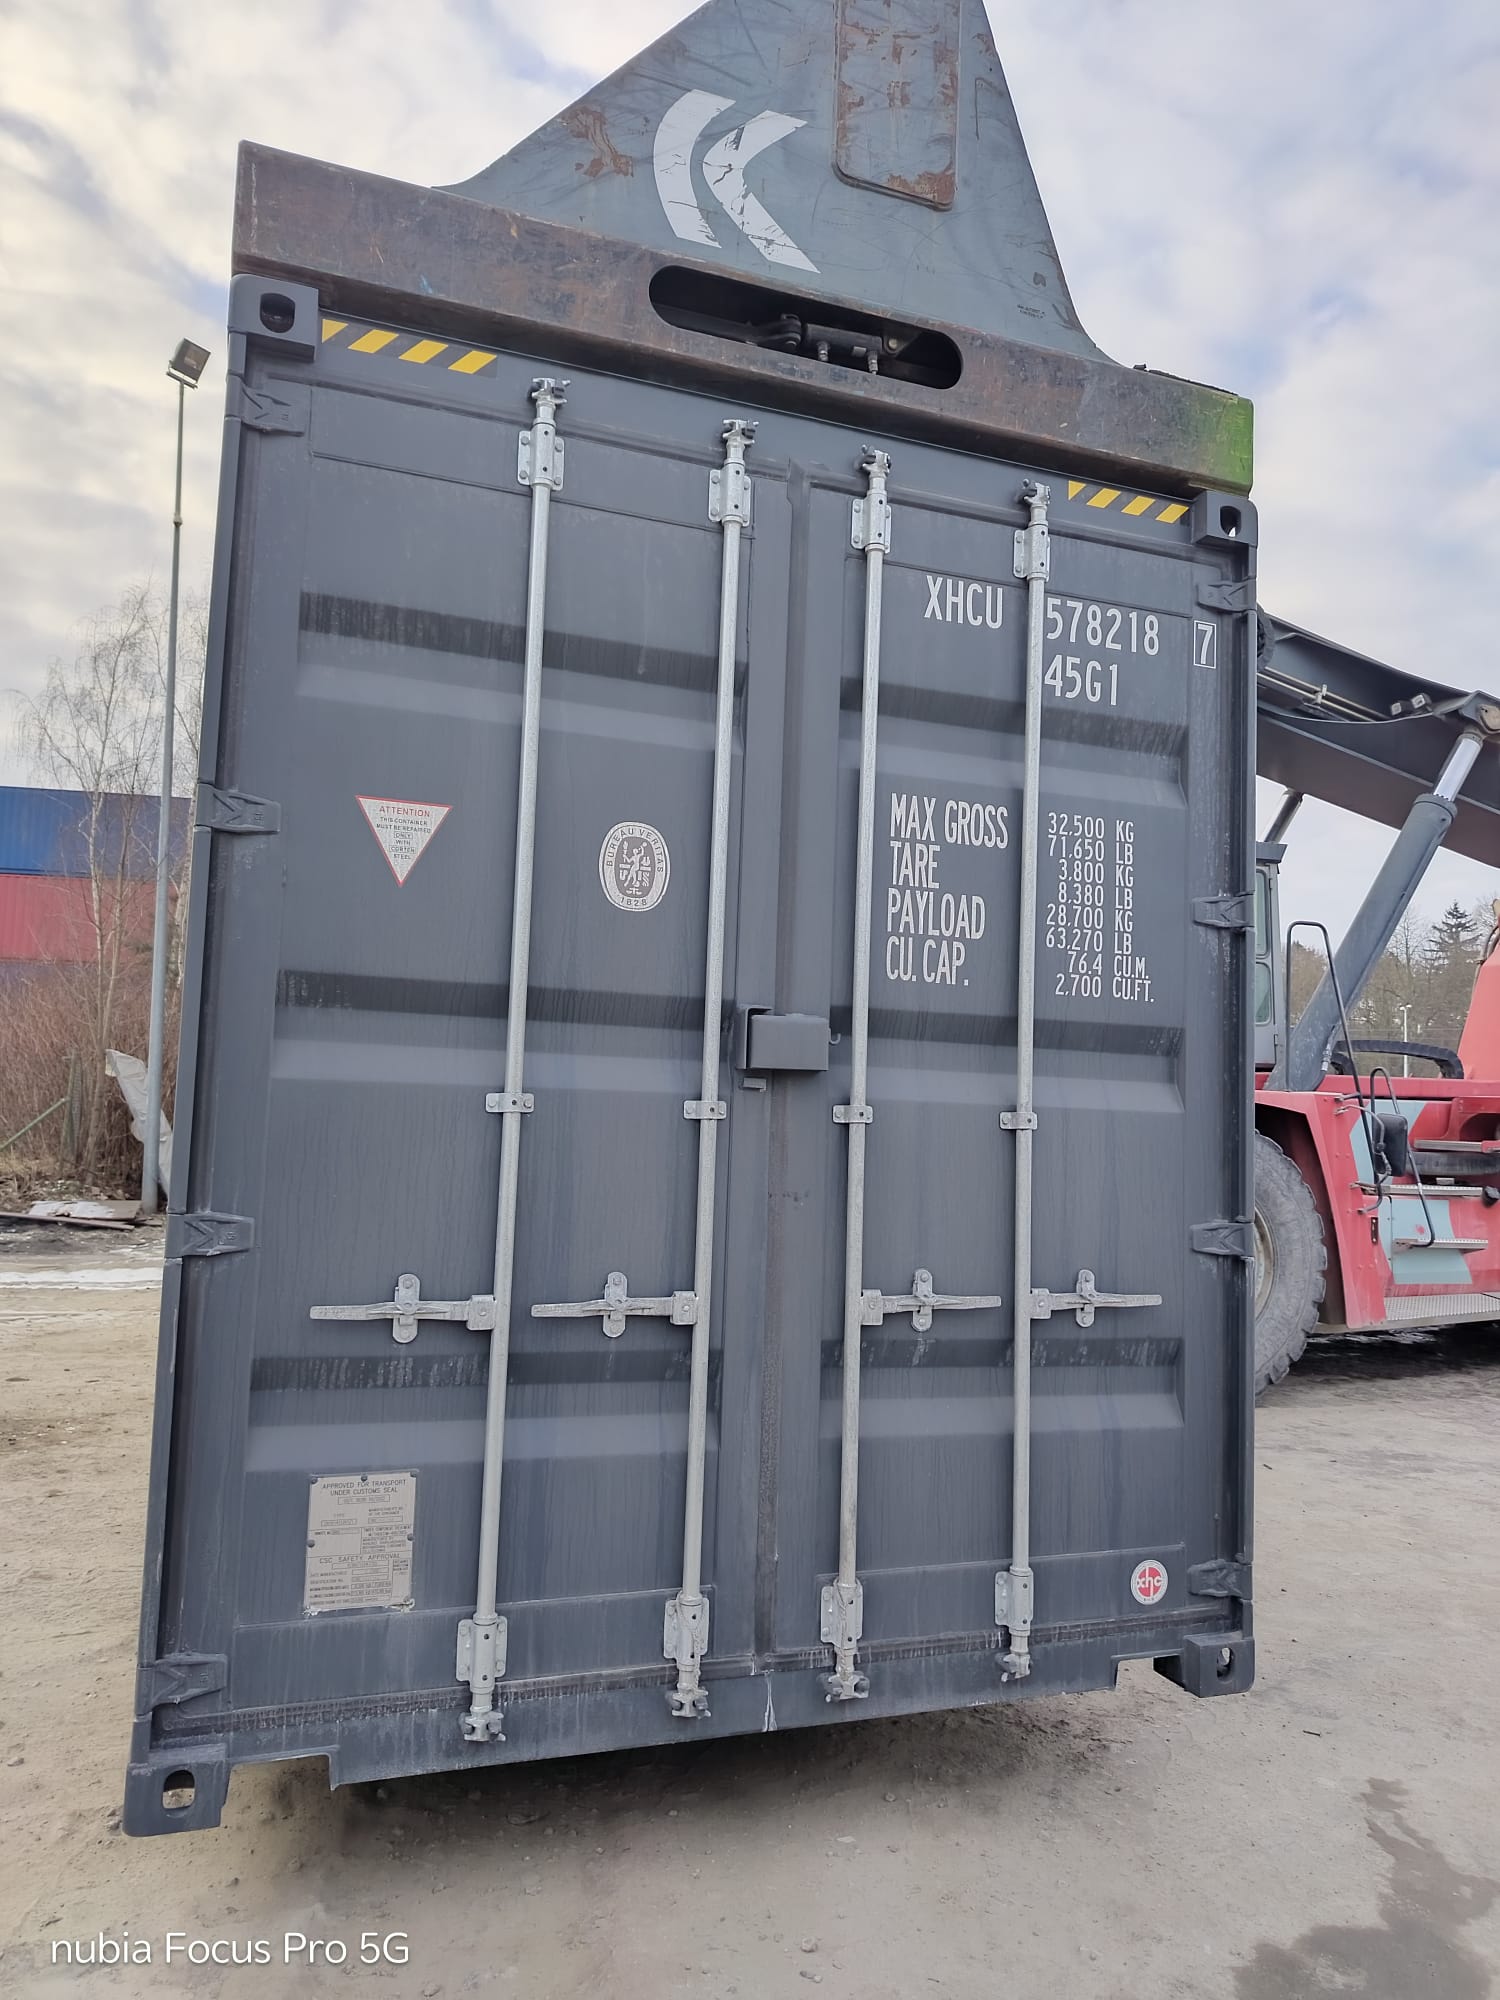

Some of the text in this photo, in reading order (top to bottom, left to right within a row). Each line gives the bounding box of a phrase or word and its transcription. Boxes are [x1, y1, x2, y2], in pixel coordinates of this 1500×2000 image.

[924, 575, 1214, 665] XHCU 578218 7
[1044, 654, 1118, 706] 45G1
[379, 806, 430, 817] ATTENTION
[890, 793, 1008, 849] MAX GROSS
[1048, 812, 1134, 843] 32,500 KG
[606, 827, 634, 867] BUREAU
[639, 828, 664, 873] VERITAS
[1048, 835, 1133, 865] 71,650 LB
[890, 841, 940, 889] TARE
[1059, 859, 1134, 888] 3,800 KG
[620, 896, 648, 907] 1828
[1058, 881, 1133, 910] 8,380 LB
[887, 888, 986, 940] PAYLOAD
[1046, 904, 1133, 932] 28,700 KG
[1046, 927, 1132, 955] 63,270 LB
[886, 936, 969, 986] CU. CAP.
[1068, 951, 1102, 975] 76.4
[1055, 974, 1101, 998] 2,700
[330, 1488, 350, 1496] UNDER
[353, 1487, 380, 1495] CUSTOMS
[372, 1479, 406, 1487] TRANSPORT
[338, 1555, 363, 1563] SAFETY
